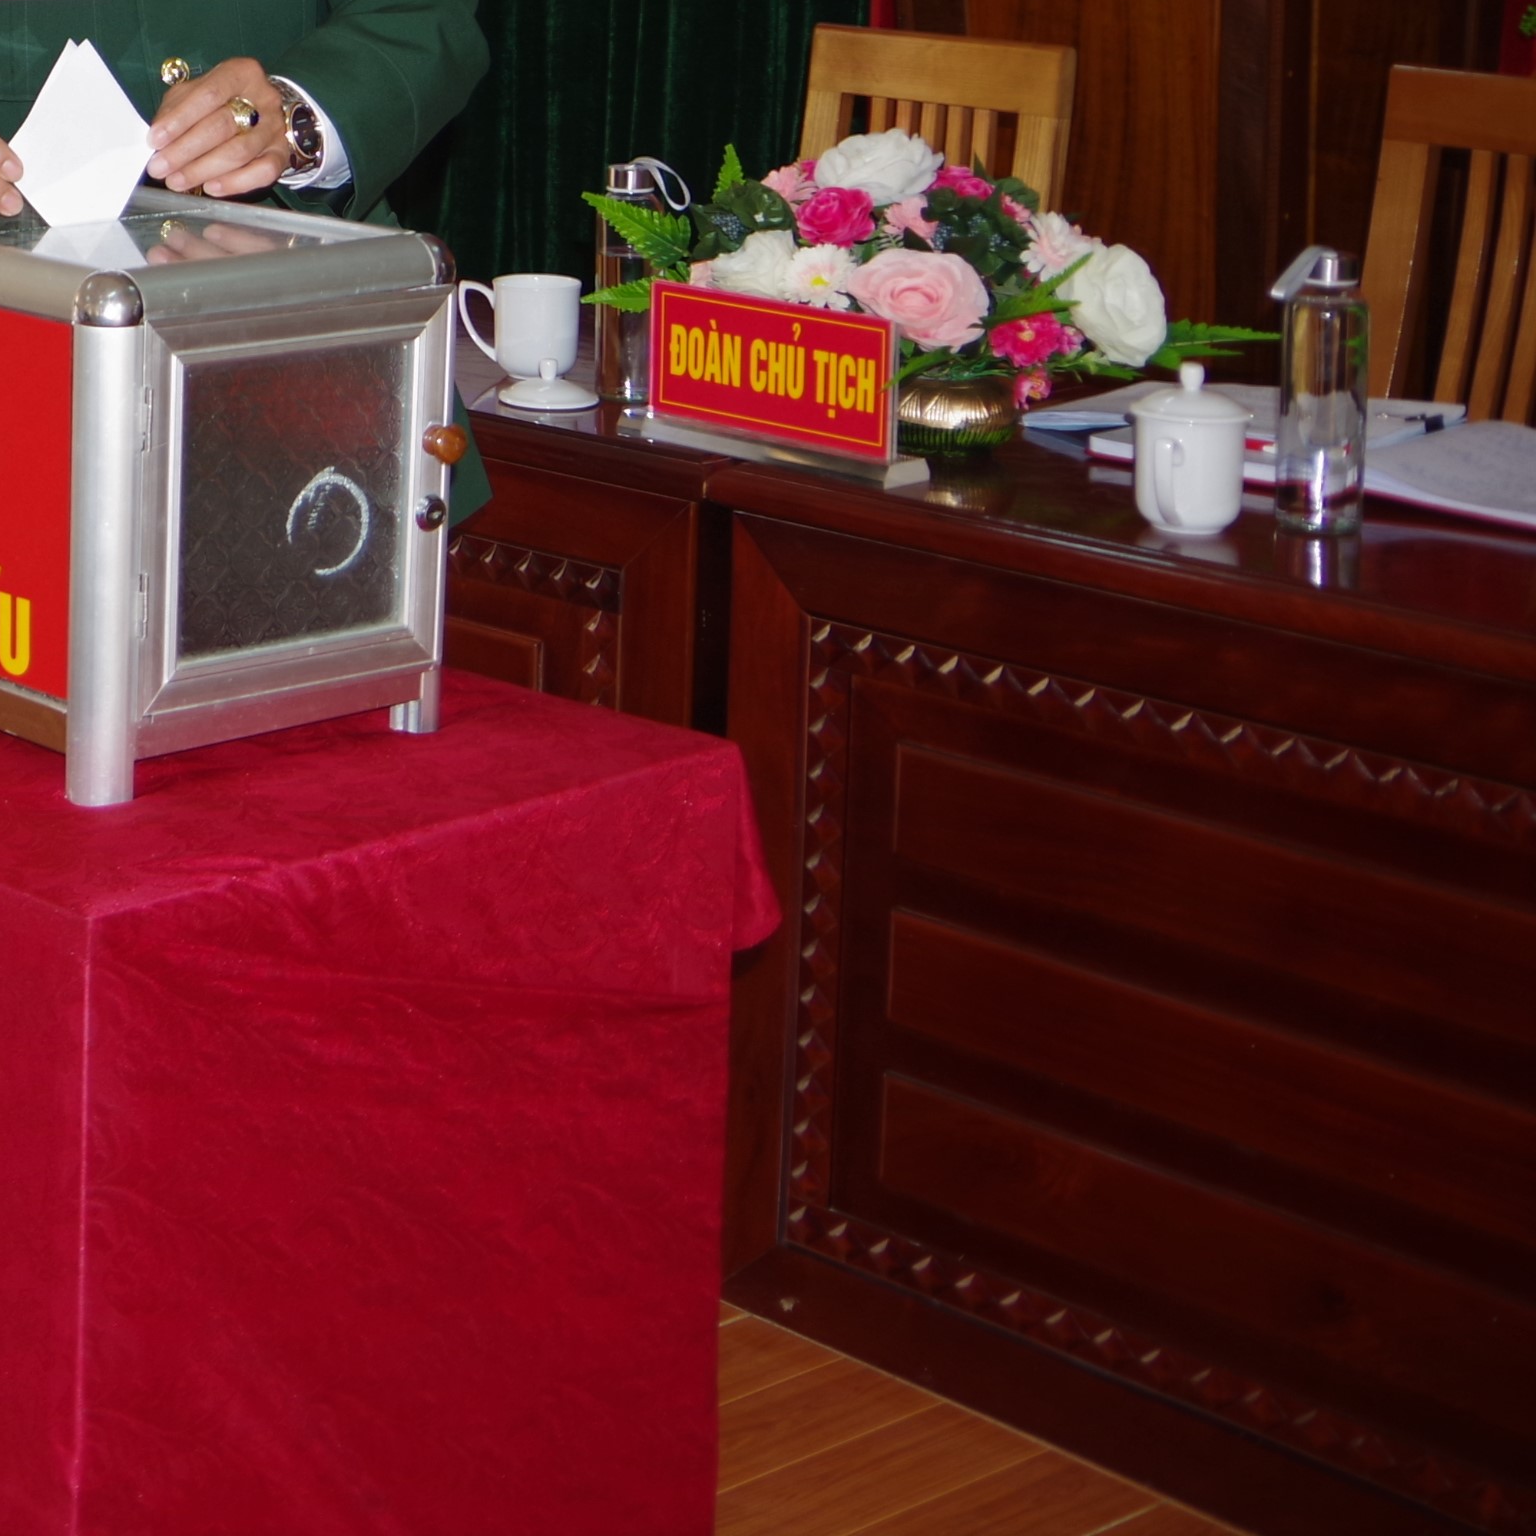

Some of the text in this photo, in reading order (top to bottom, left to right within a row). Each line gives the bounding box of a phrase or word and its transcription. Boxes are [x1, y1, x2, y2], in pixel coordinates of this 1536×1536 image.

[669, 319, 876, 419] ĐOÀN CHỦ TỊCH
